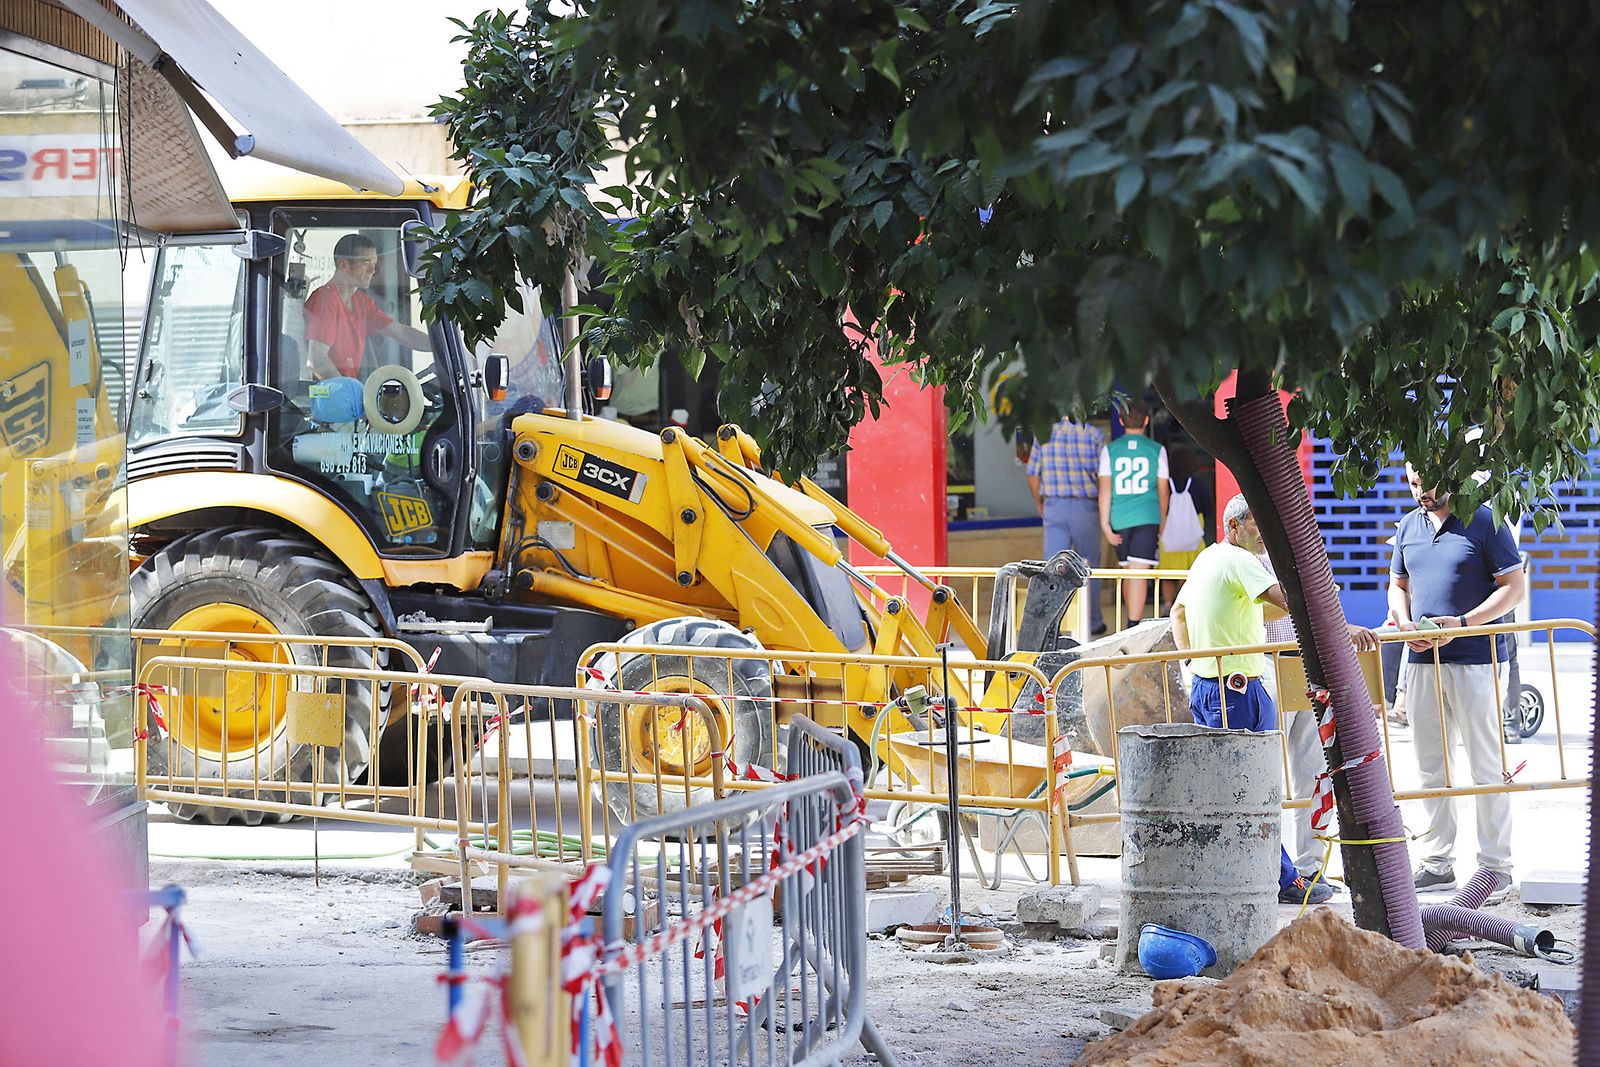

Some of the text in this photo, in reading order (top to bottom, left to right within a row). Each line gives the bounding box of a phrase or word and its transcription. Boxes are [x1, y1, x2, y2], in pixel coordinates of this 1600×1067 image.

[352, 456, 367, 473] 813
[562, 453, 631, 491] JCB 3CX
[1115, 457, 1149, 495] 22
[387, 498, 429, 532] JCB
